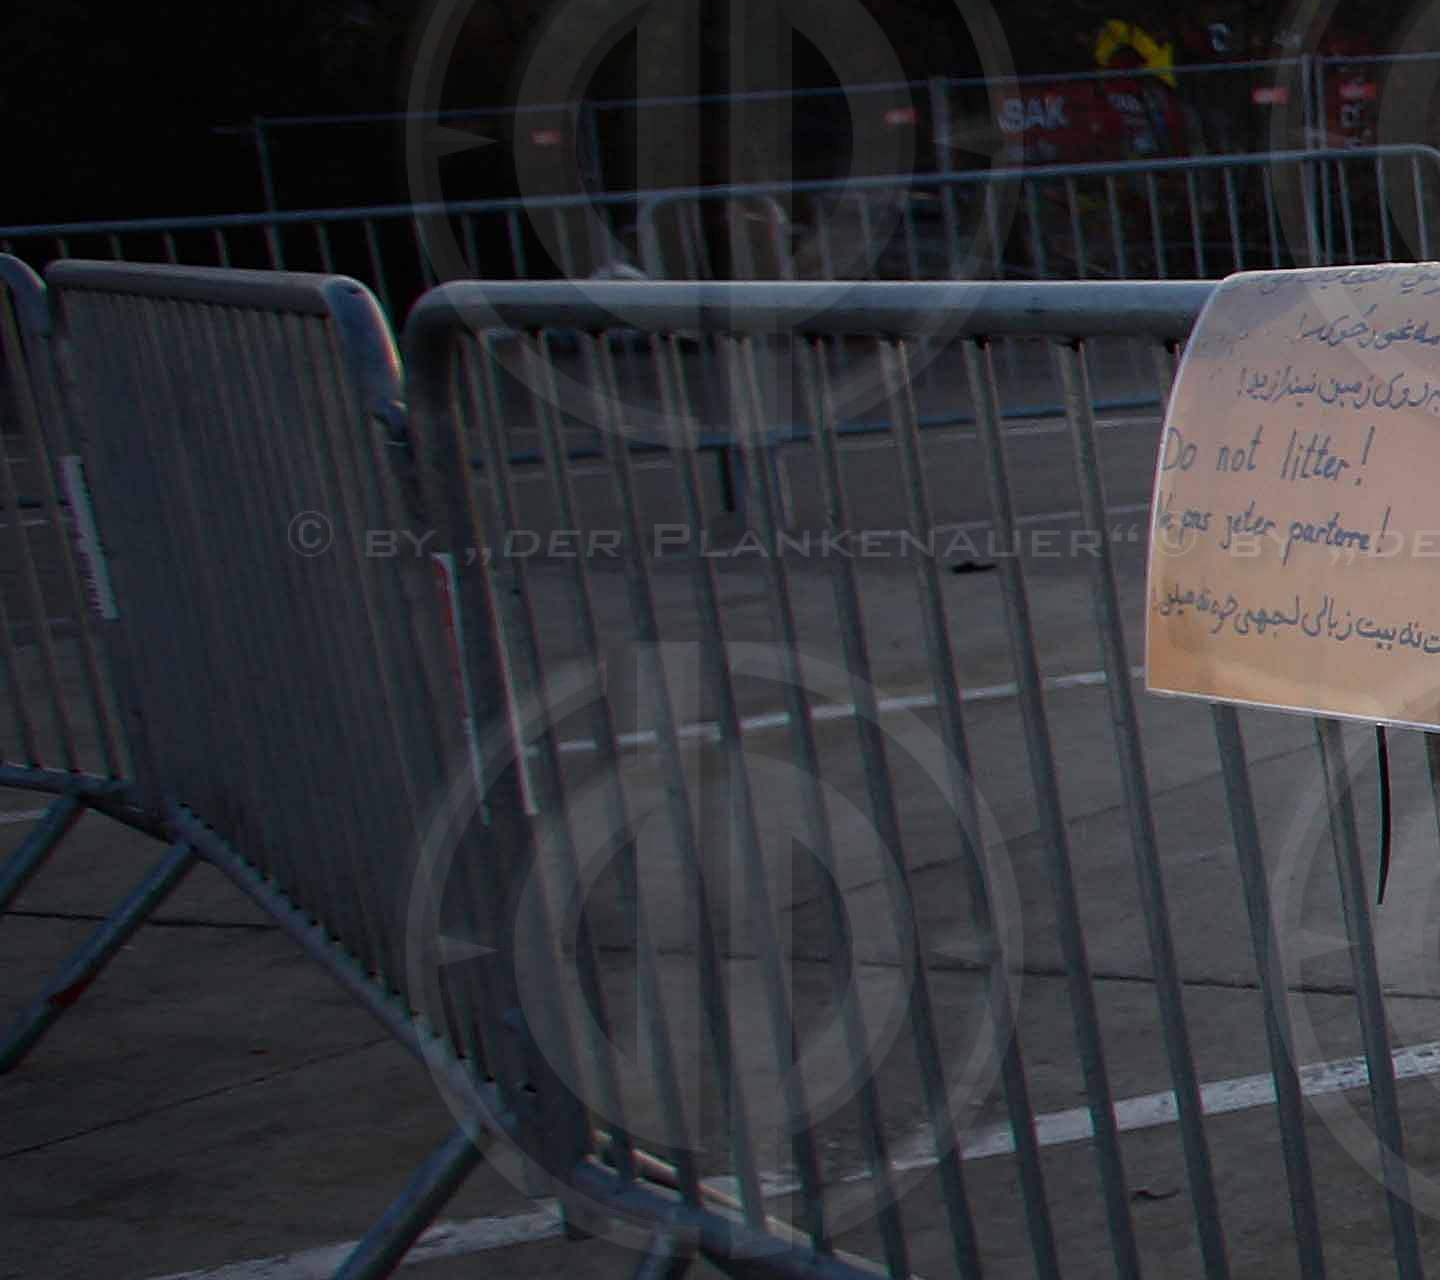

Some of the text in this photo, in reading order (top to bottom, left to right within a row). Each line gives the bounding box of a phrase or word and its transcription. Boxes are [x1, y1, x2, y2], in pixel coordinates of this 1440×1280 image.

[1162, 424, 1376, 486] Do not litter!
